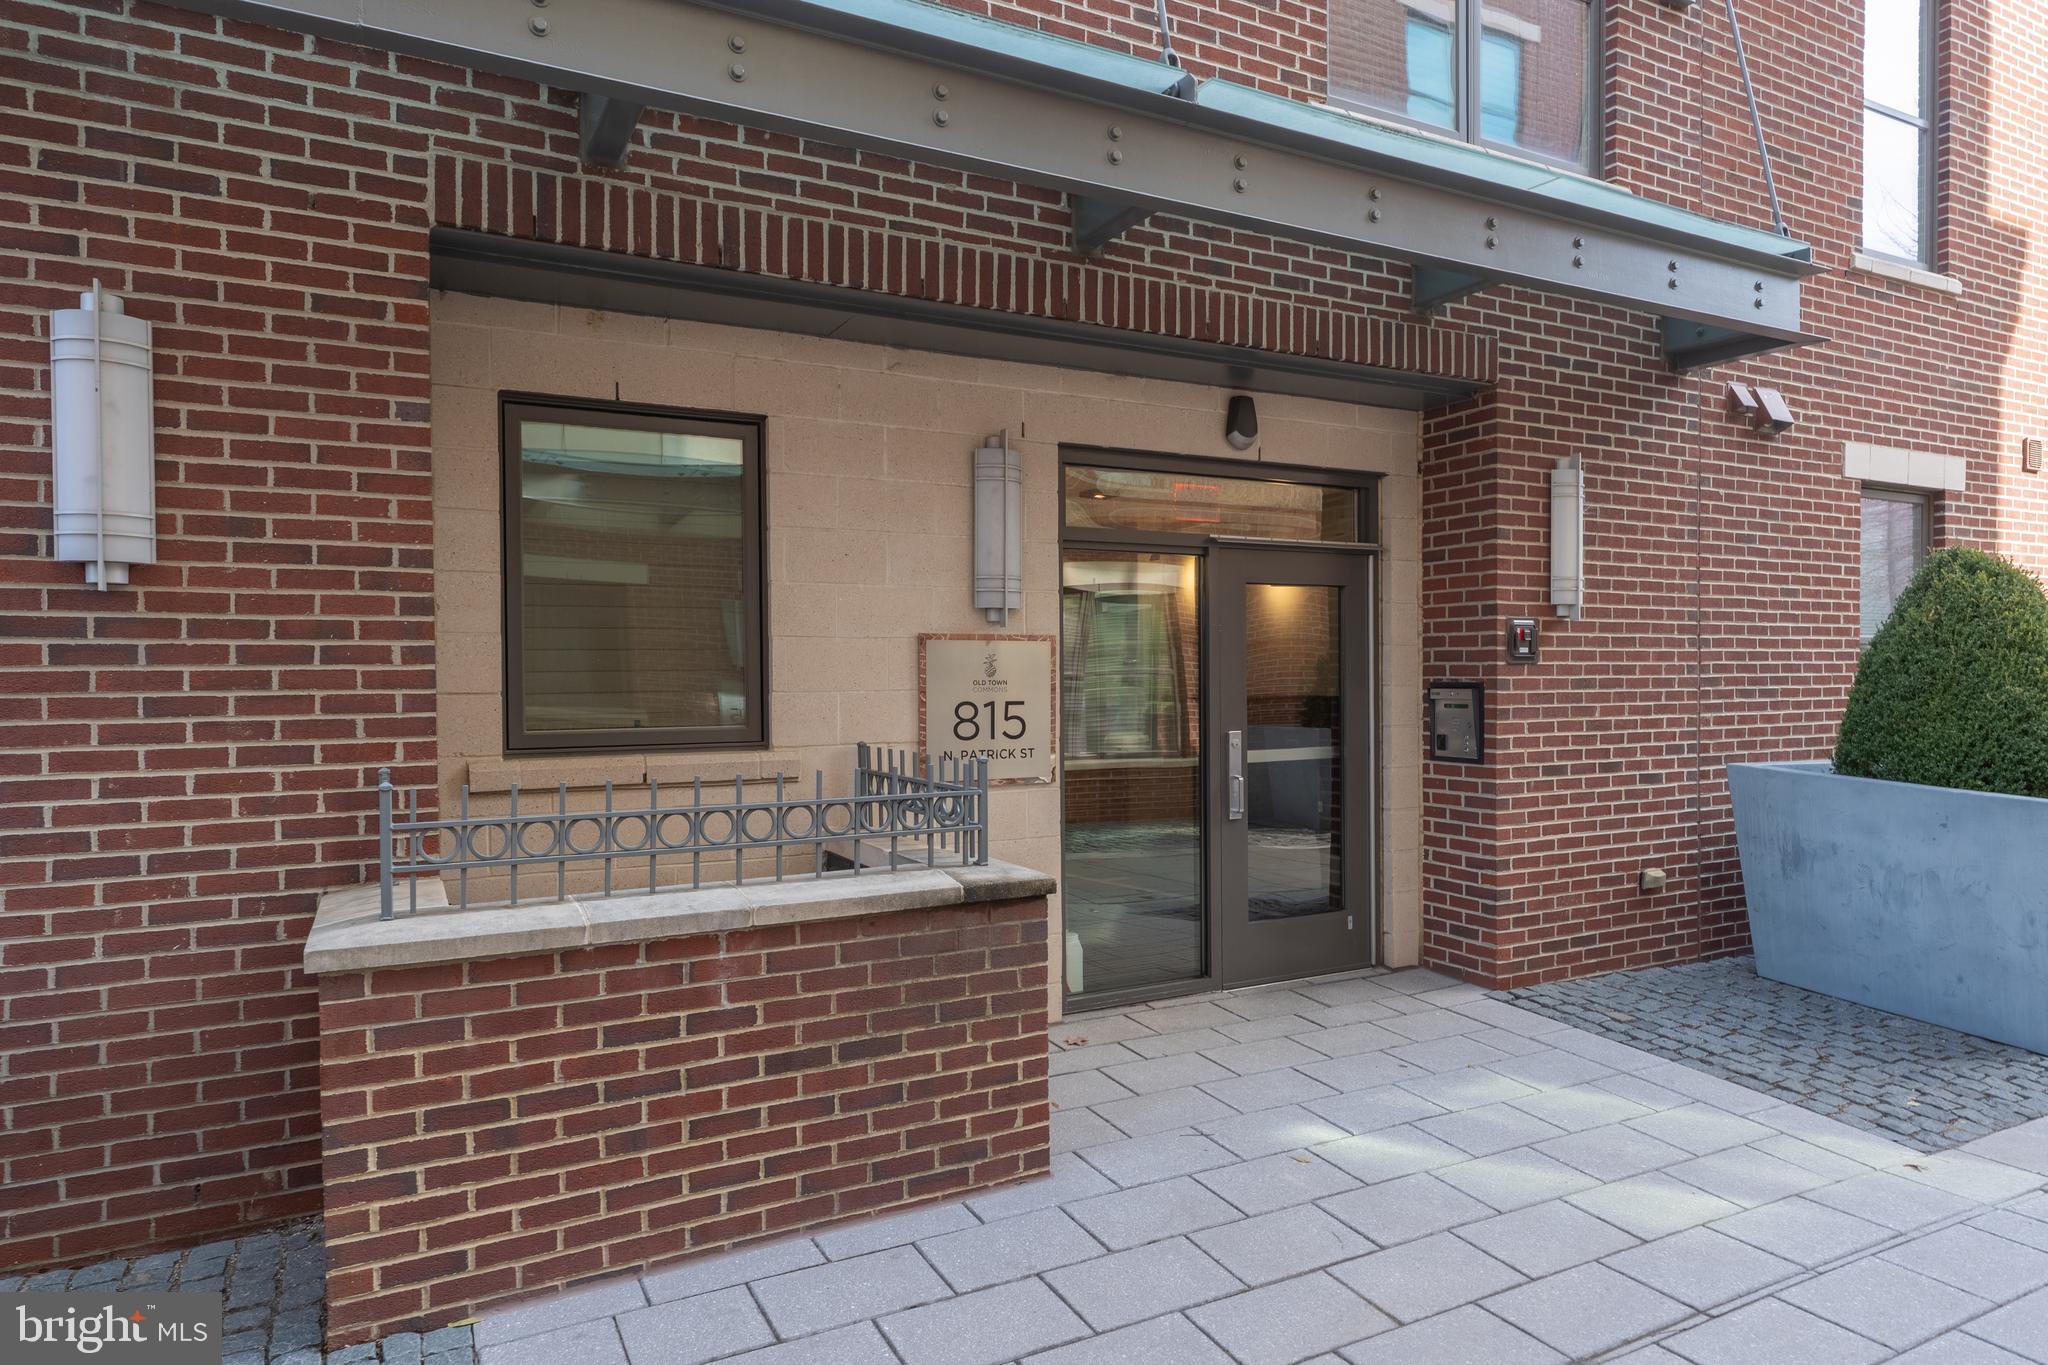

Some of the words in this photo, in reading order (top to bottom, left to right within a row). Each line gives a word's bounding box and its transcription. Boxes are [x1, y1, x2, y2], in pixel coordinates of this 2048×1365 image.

[953, 700, 1027, 741] 815
[943, 750, 953, 761] N
[960, 748, 1017, 760] PATRICK
[1020, 747, 1035, 759] ST
